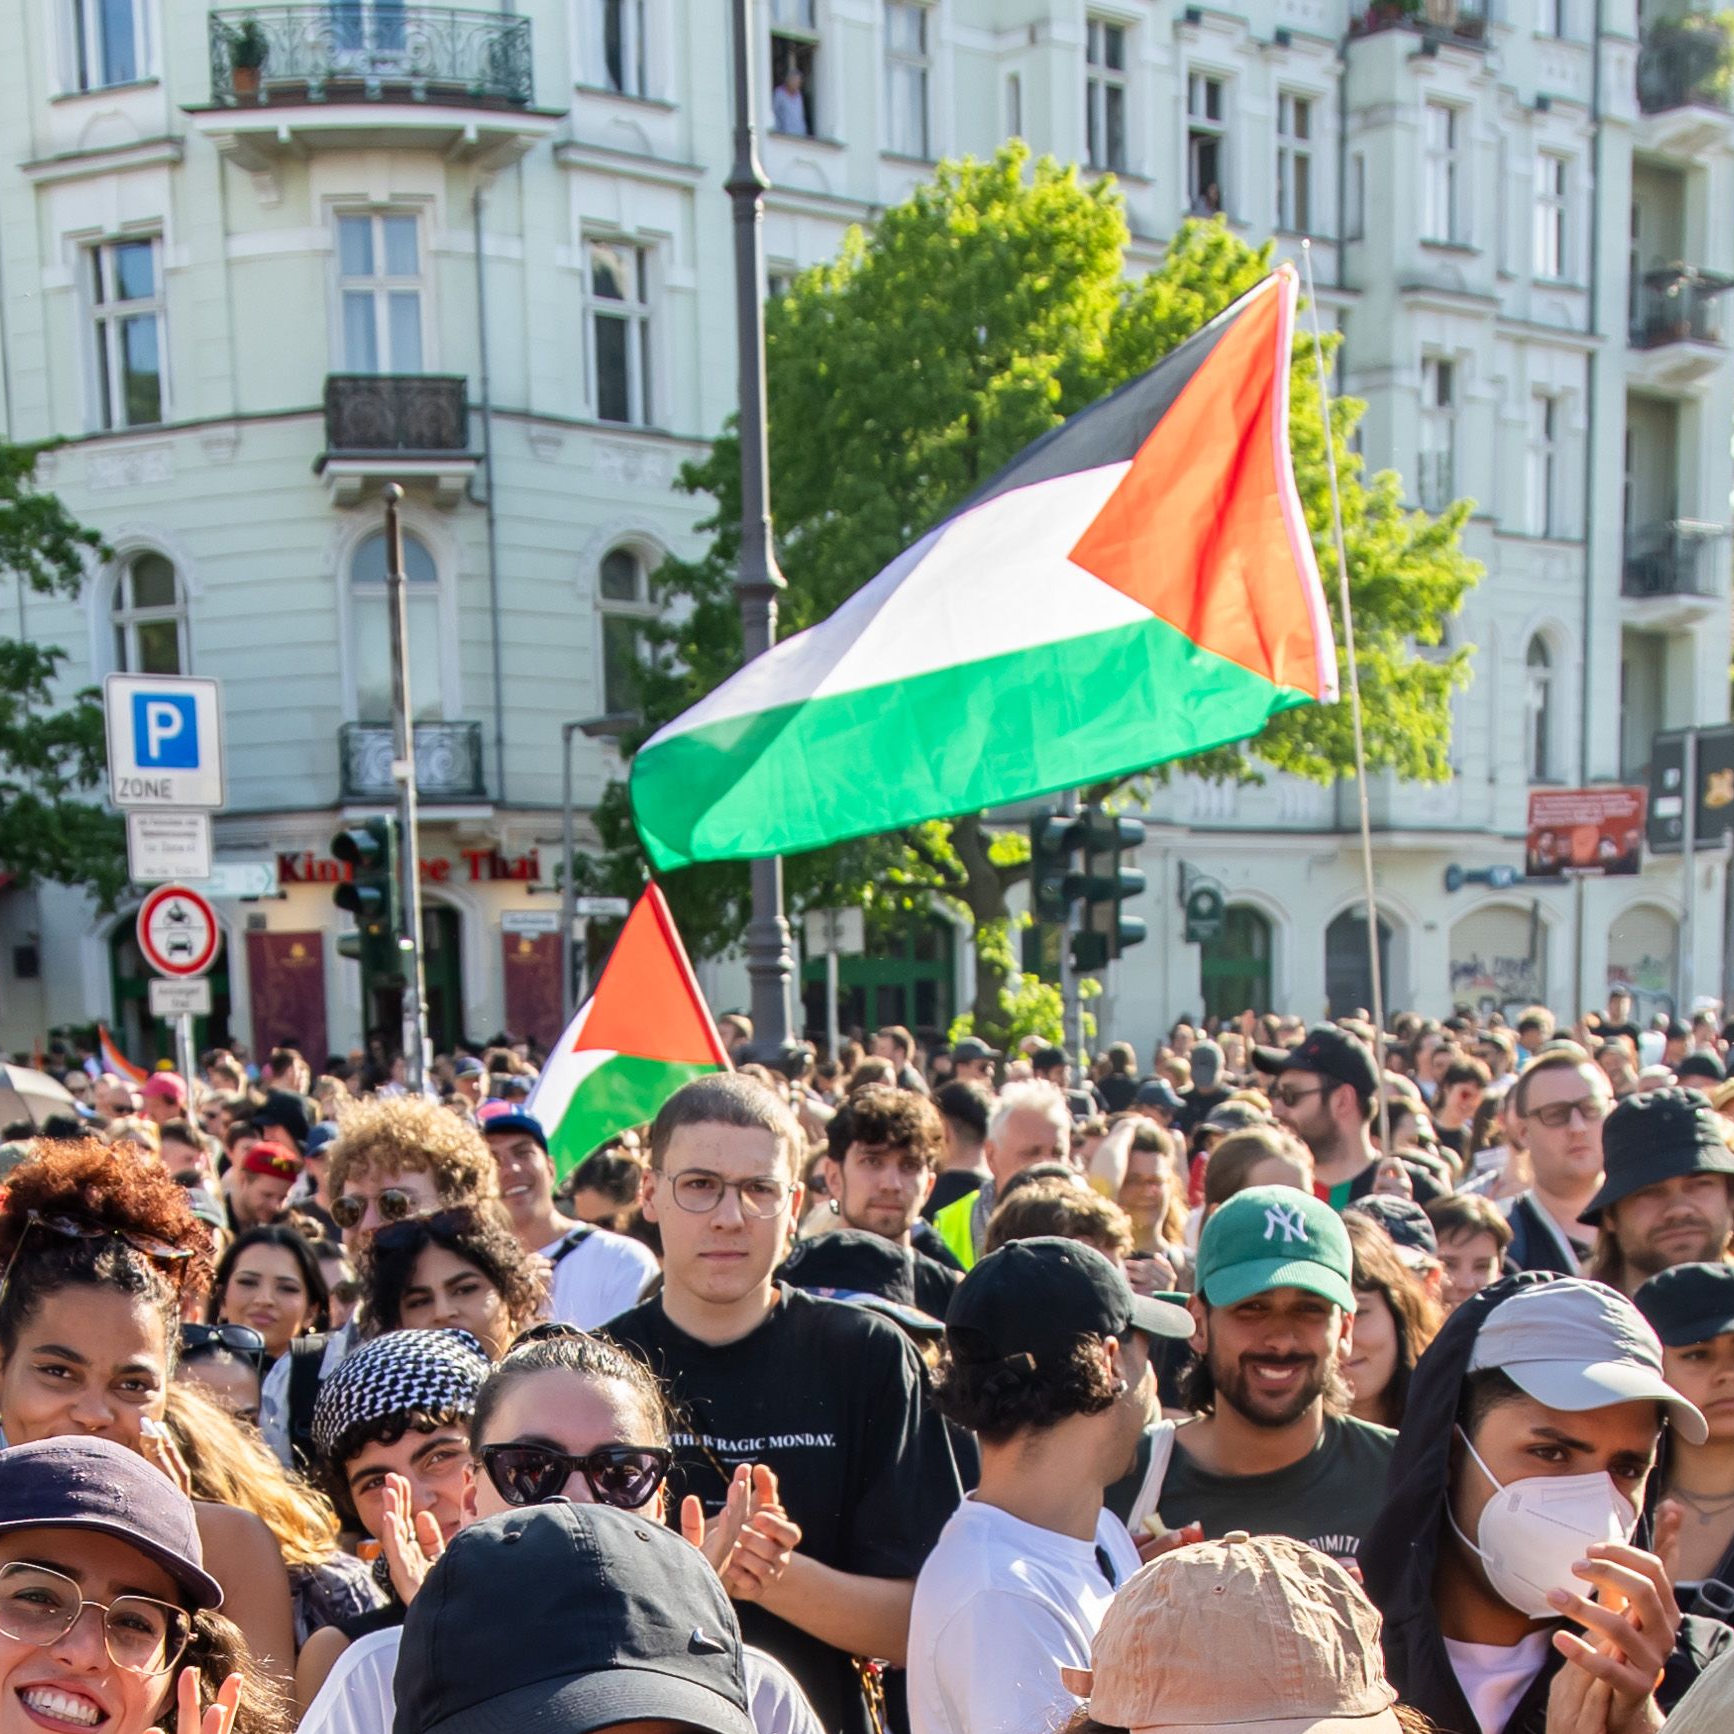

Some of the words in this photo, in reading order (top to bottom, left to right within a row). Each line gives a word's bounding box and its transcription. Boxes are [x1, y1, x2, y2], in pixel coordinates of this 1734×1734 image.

[146, 701, 183, 760] P
[119, 777, 173, 800] ZONE
[460, 847, 541, 881] Thai
[1263, 1202, 1309, 1242] NY
[769, 1433, 836, 1448] MONDAY.
